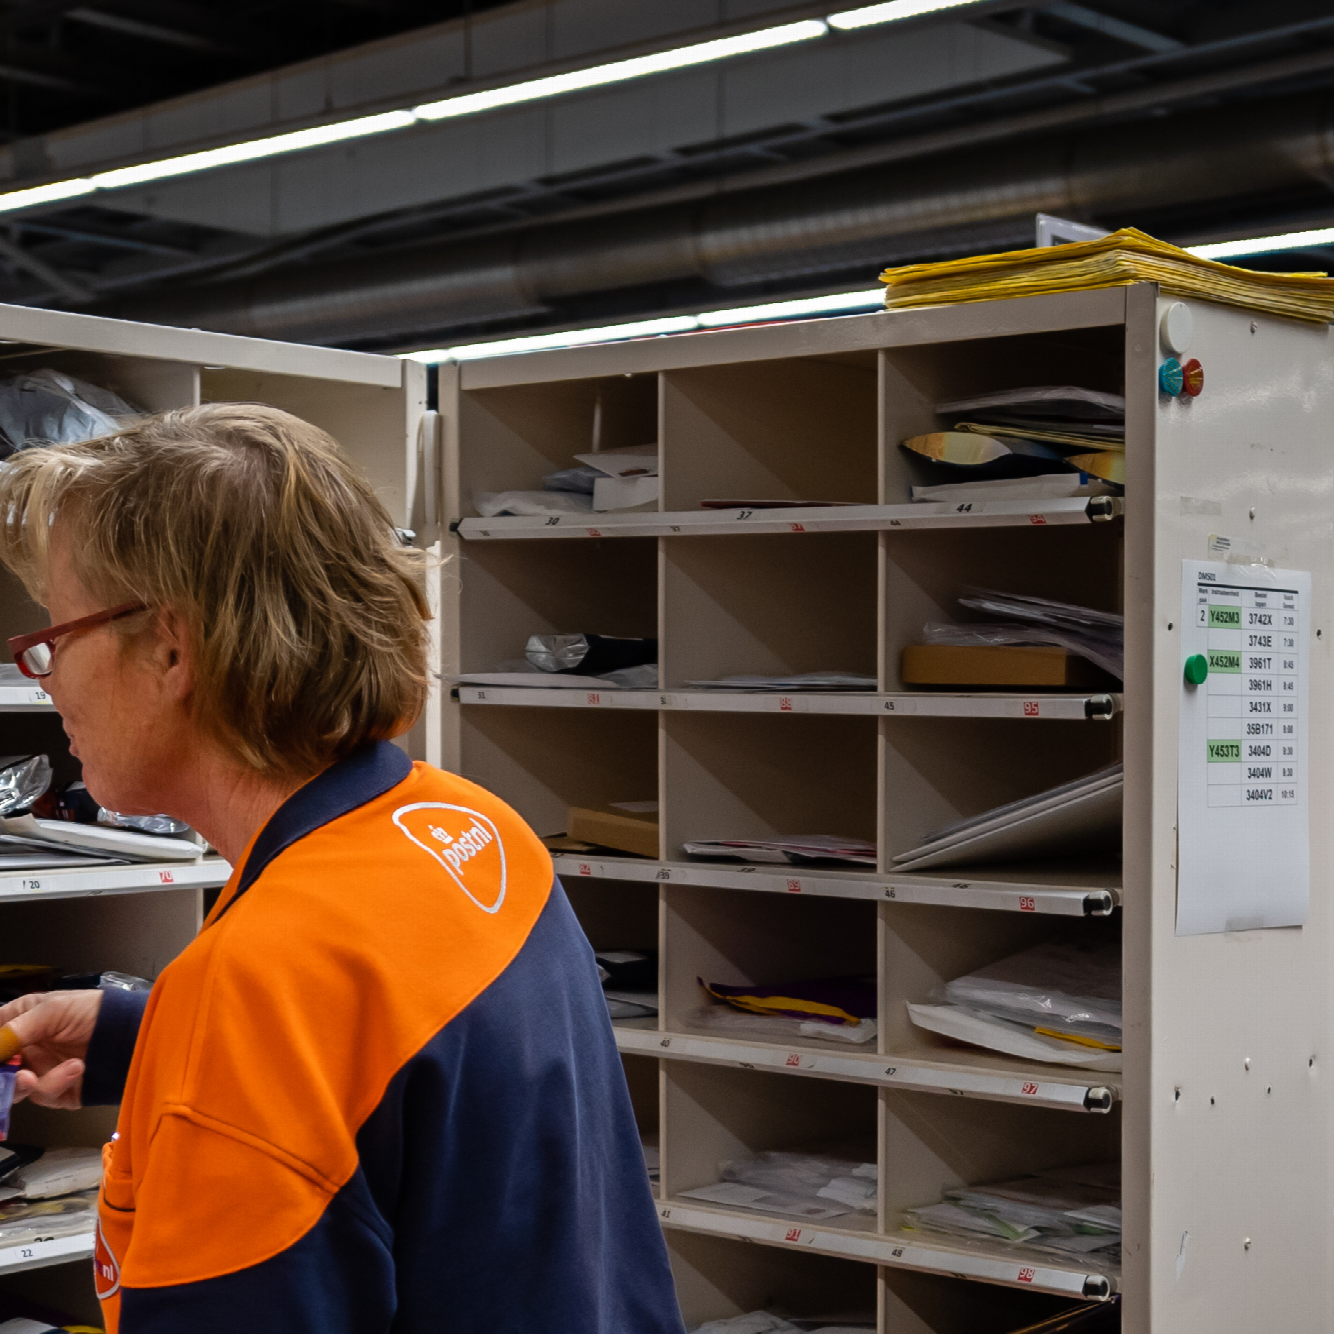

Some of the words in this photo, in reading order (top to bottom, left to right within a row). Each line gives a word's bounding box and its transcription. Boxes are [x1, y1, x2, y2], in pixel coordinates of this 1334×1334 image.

[956, 503, 973, 513] 44
[736, 511, 753, 520] 37
[544, 517, 560, 526] 30
[1200, 610, 1205, 621] 2
[1210, 612, 1240, 624] Y452M3
[1248, 613, 1272, 626] 3742X
[1248, 635, 1272, 647] 3743E
[1209, 656, 1240, 668] X452M4
[1248, 657, 1272, 669] 3961T
[1248, 679, 1272, 691] 3961H
[35, 690, 46, 700] 19
[884, 701, 895, 711] 45
[1024, 701, 1039, 716] 95
[1248, 702, 1272, 713] 3431X
[1246, 724, 1273, 735] 35B171
[1209, 745, 1240, 758] Y453T3
[1248, 745, 1271, 757] 3404D
[1247, 767, 1272, 779] 3404W
[1246, 789, 1273, 801] 3404V2
[442, 817, 493, 876] postnl
[159, 870, 174, 883] 70
[30, 879, 40, 890] 20
[884, 890, 896, 899] 46
[1019, 896, 1036, 911] 96
[659, 1039, 671, 1048] 40
[884, 1067, 897, 1076] 47
[1021, 1081, 1040, 1095] 97
[660, 1210, 671, 1219] 41
[784, 1228, 802, 1242] 91
[21, 1248, 33, 1258] 22
[891, 1248, 903, 1258] 48
[1017, 1267, 1036, 1283] 98
